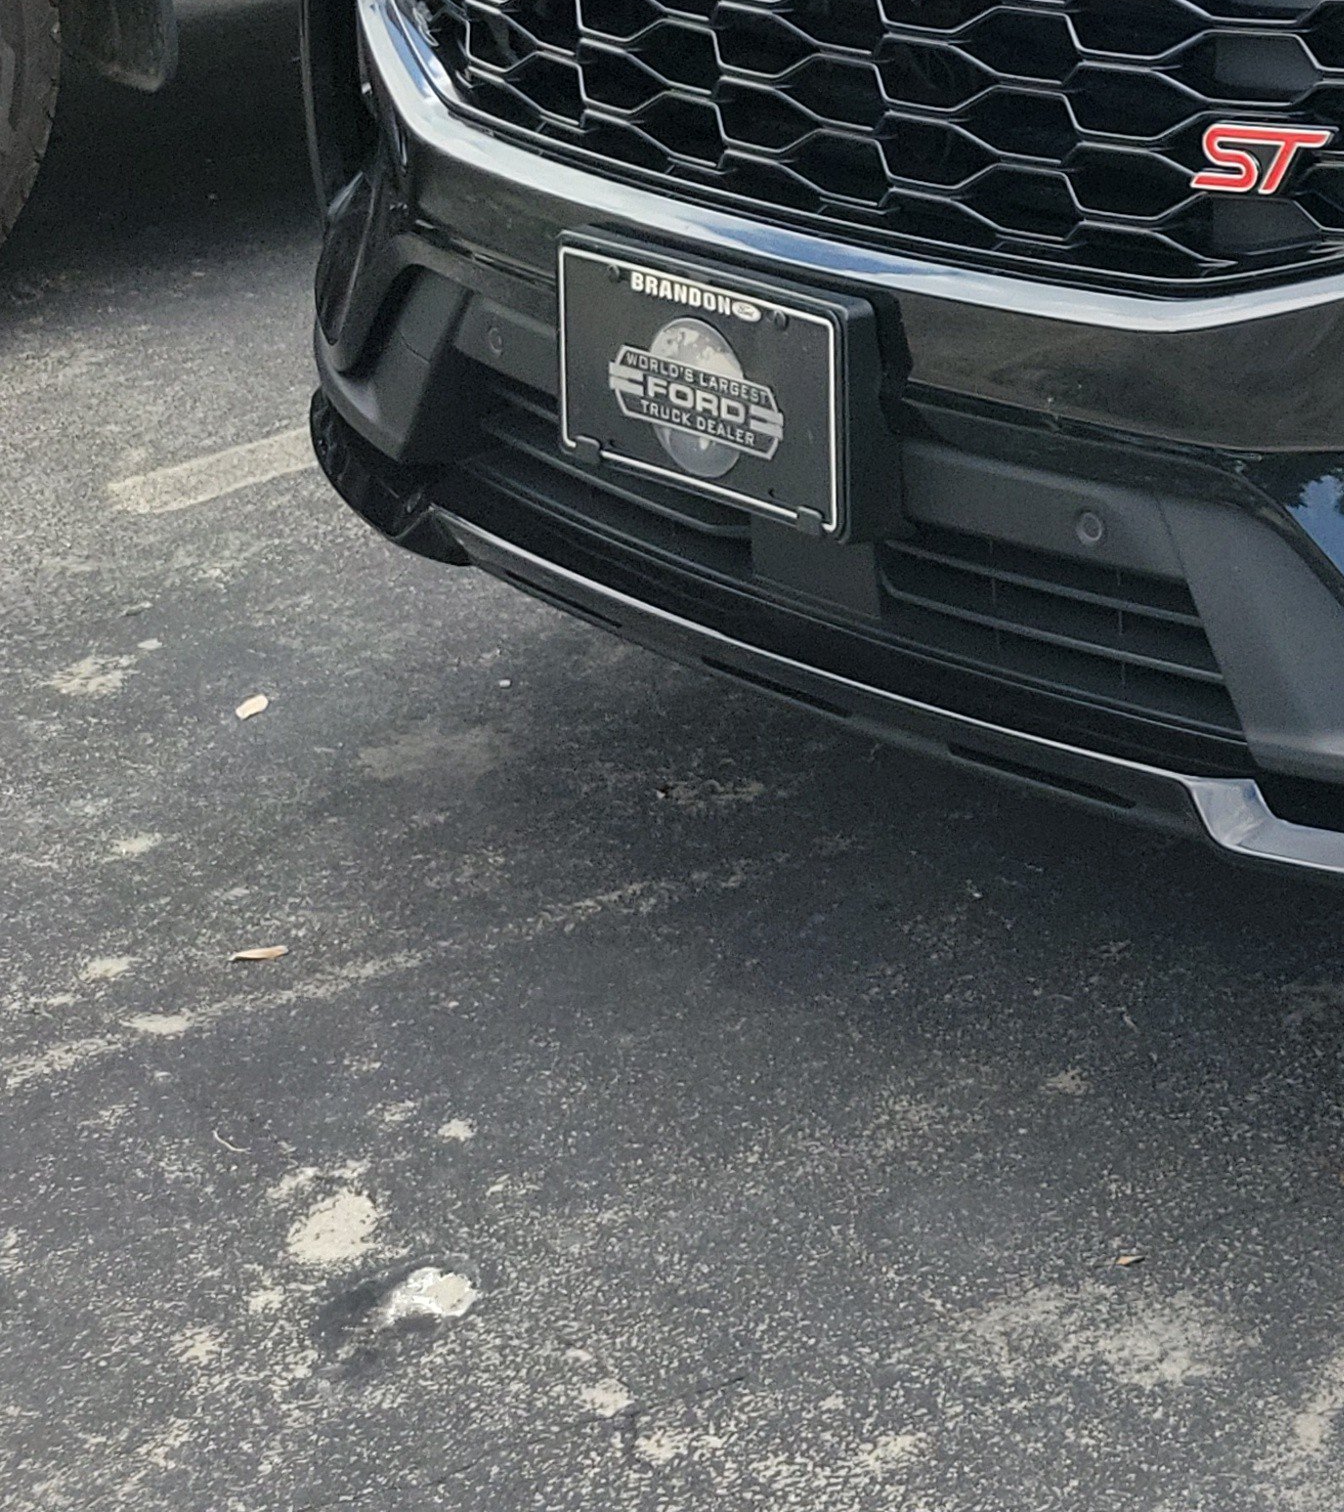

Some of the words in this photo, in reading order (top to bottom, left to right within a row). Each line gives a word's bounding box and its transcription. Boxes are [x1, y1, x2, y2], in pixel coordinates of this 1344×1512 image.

[1189, 121, 1335, 195] ST
[630, 270, 732, 316] BRANDON
[625, 351, 695, 384] WORLD'S
[699, 372, 769, 405] LARGEST
[646, 375, 746, 425] FORD
[640, 398, 692, 427] TRUCK
[695, 416, 756, 447] DEALER
